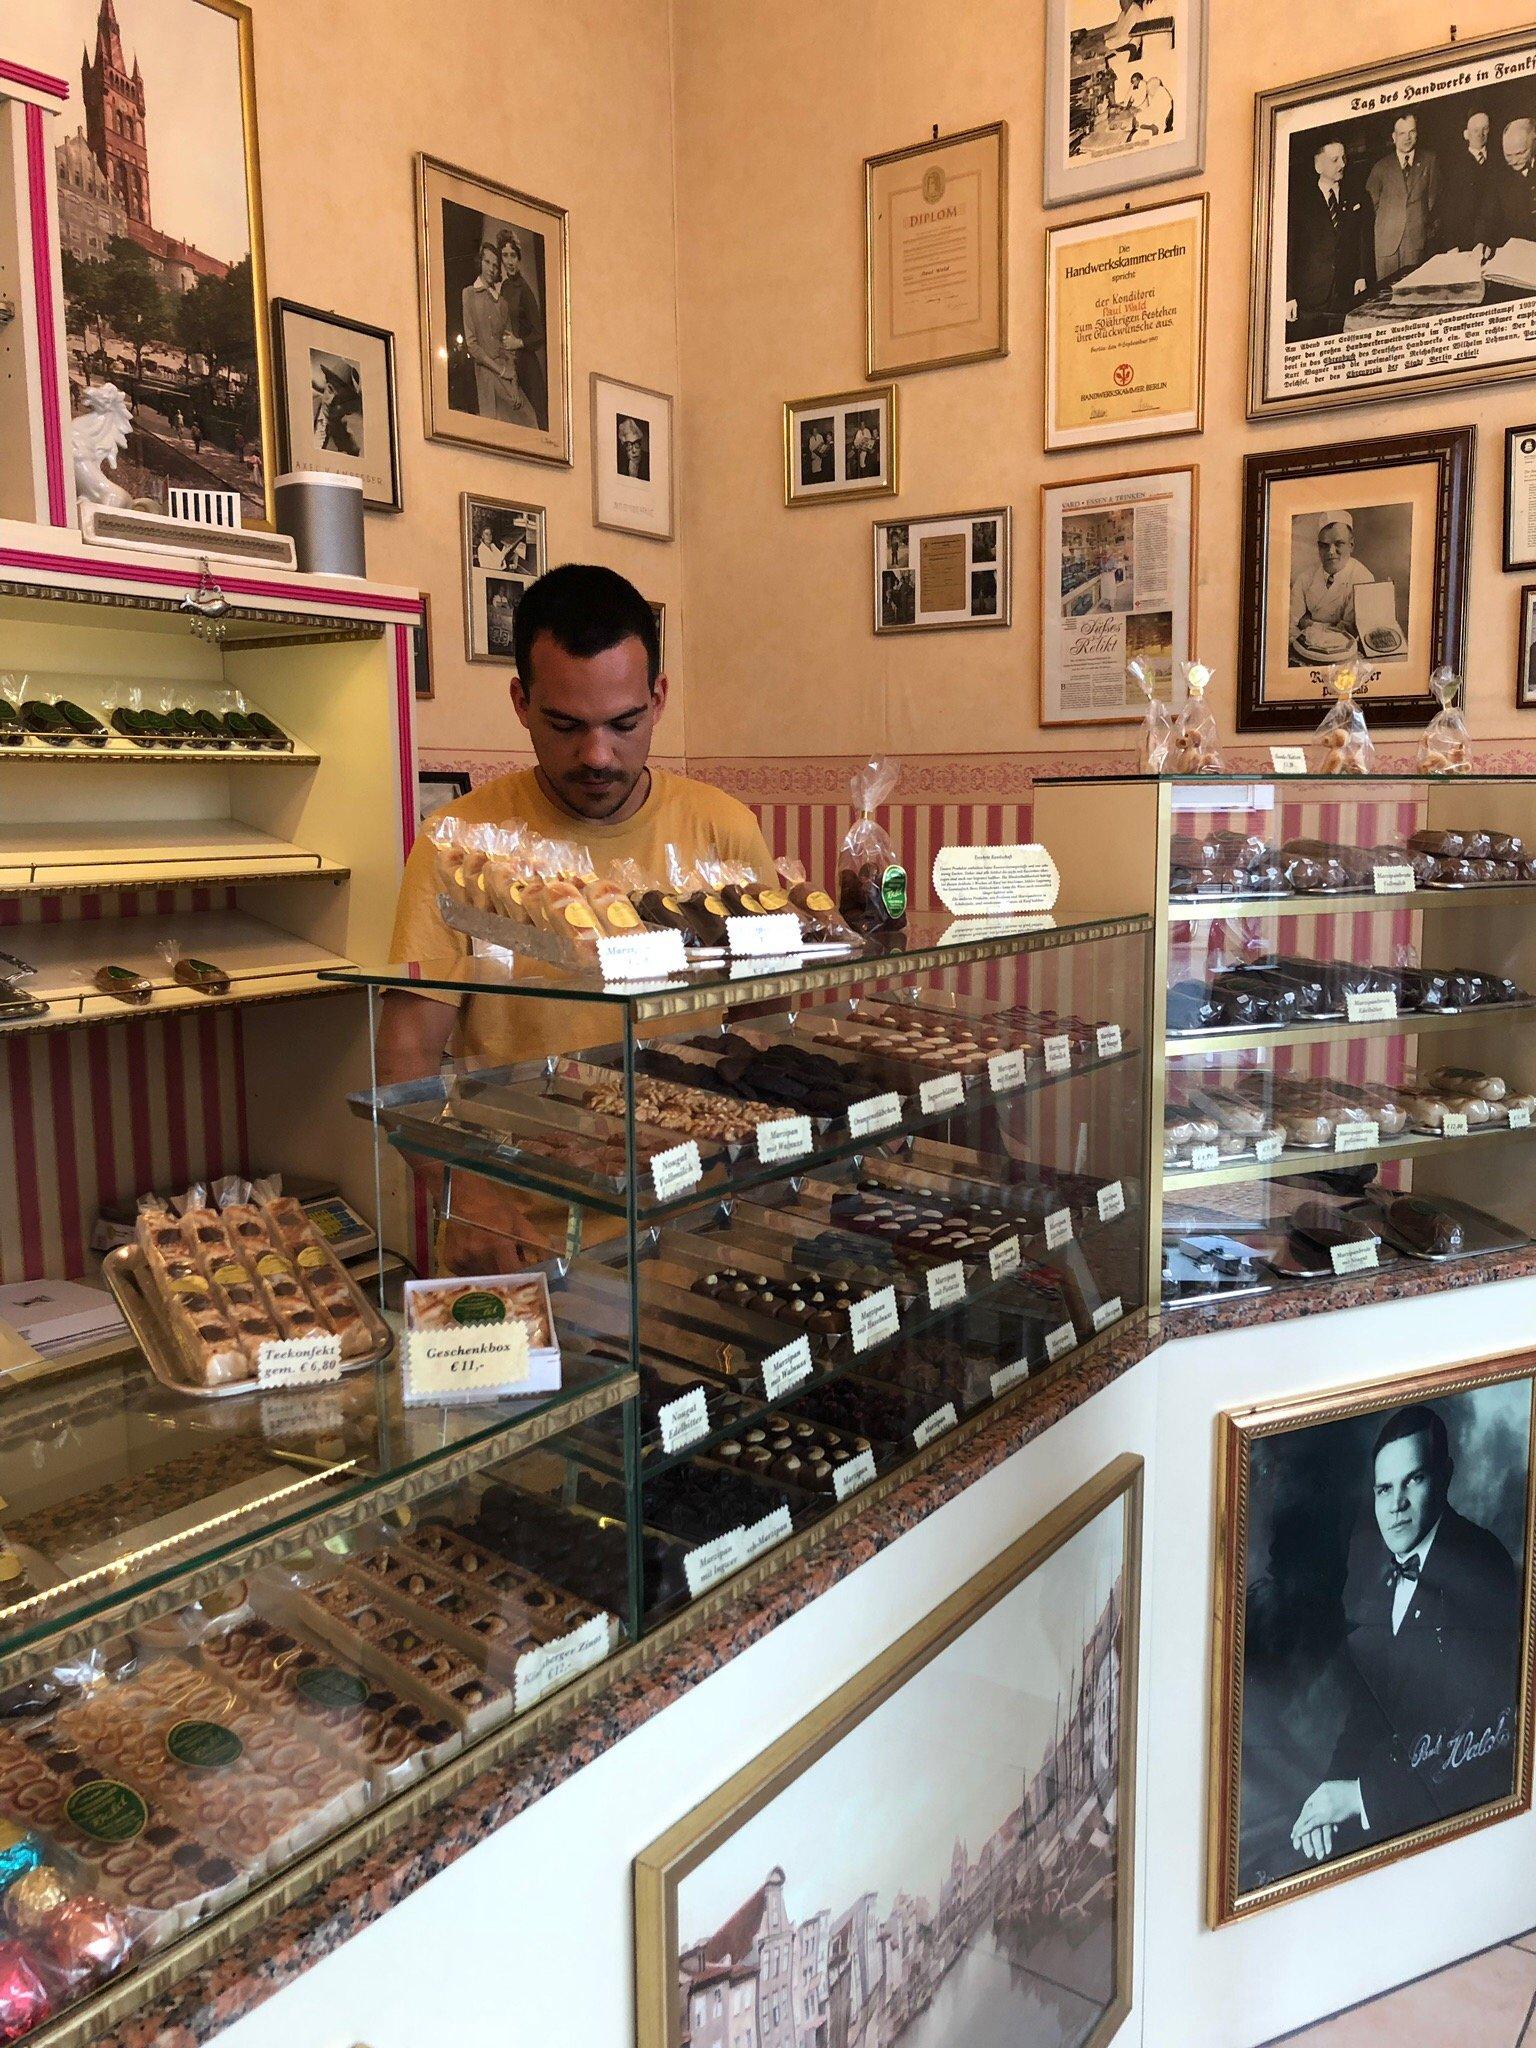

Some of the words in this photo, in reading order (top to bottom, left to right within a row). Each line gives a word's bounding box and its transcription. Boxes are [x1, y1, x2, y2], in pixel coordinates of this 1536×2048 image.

[1350, 99, 1376, 111] Tag
[1379, 92, 1399, 105] des
[1404, 73, 1472, 101] Handwerks
[1476, 71, 1489, 81] in
[909, 206, 958, 228] DIPLOM
[1118, 244, 1130, 254] Die
[1065, 252, 1158, 279] Handwerkskammer
[1157, 245, 1186, 260] Berlin
[1111, 270, 1136, 283] spricht
[1095, 298, 1110, 309] der
[1112, 287, 1156, 305] Konditorei
[1102, 306, 1122, 317] Paul
[1124, 300, 1147, 313] Wald
[1074, 323, 1093, 333] zum
[1141, 306, 1177, 321] Bestehen
[1080, 386, 1145, 402] HANDWERKSKAMMER
[1145, 382, 1168, 391] BERLIN
[662, 1152, 688, 1172] Nougat
[860, 1303, 886, 1321] Marzipan
[265, 1346, 336, 1360] Teekonfekt
[426, 1341, 511, 1359] Geschenkbox
[772, 1350, 801, 1373] Marzipan
[265, 1366, 296, 1379] gem.
[671, 1403, 697, 1422] Nougat
[668, 1415, 703, 1440] Edelbitter
[699, 1546, 733, 1570] Marzipan
